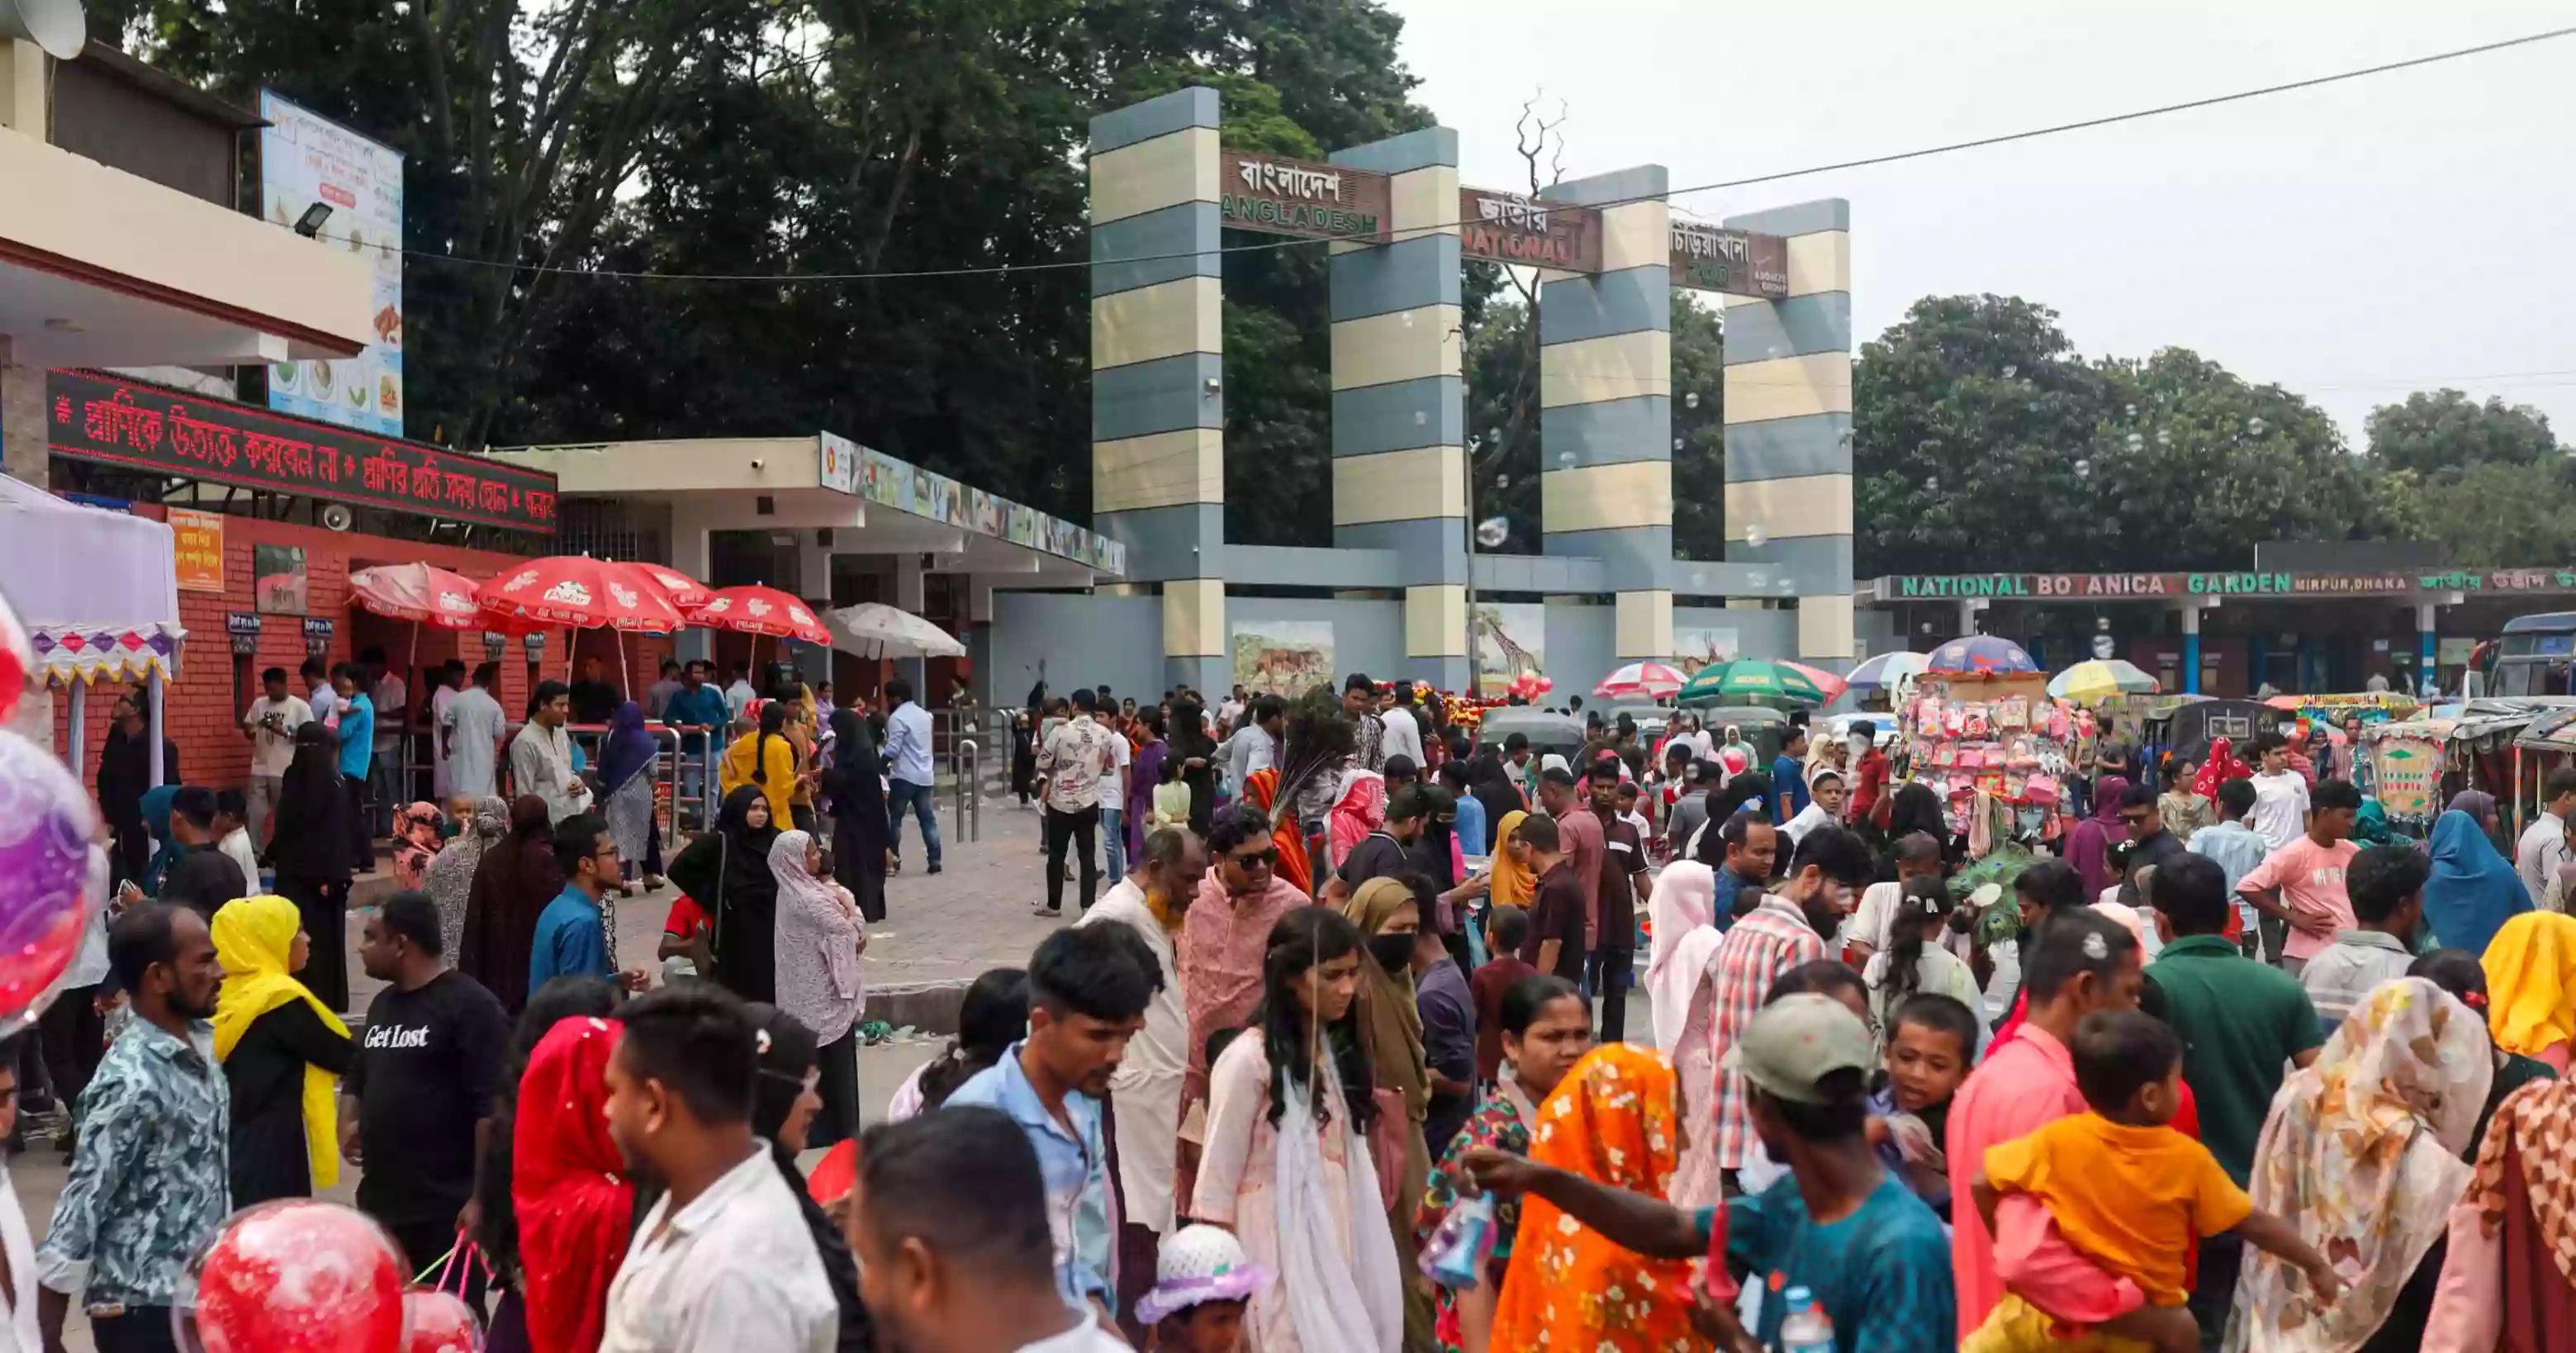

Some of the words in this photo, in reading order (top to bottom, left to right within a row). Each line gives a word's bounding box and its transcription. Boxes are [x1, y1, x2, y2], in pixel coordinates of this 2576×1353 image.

[1240, 160, 1342, 202] বাংলাদেশ
[1221, 193, 1378, 233] ANGLADESH
[1477, 191, 1549, 234] জাতীয়
[1669, 219, 1749, 263] চিড়িয়াখানা
[84, 387, 164, 452] প্রাণিকে
[317, 445, 339, 483] না
[1902, 577, 2028, 596] NATIONAL
[2037, 574, 2180, 596] BOTANICAL
[2187, 572, 2292, 595] GARDEN
[364, 1024, 391, 1048] Get
[389, 1024, 429, 1048] Lost
